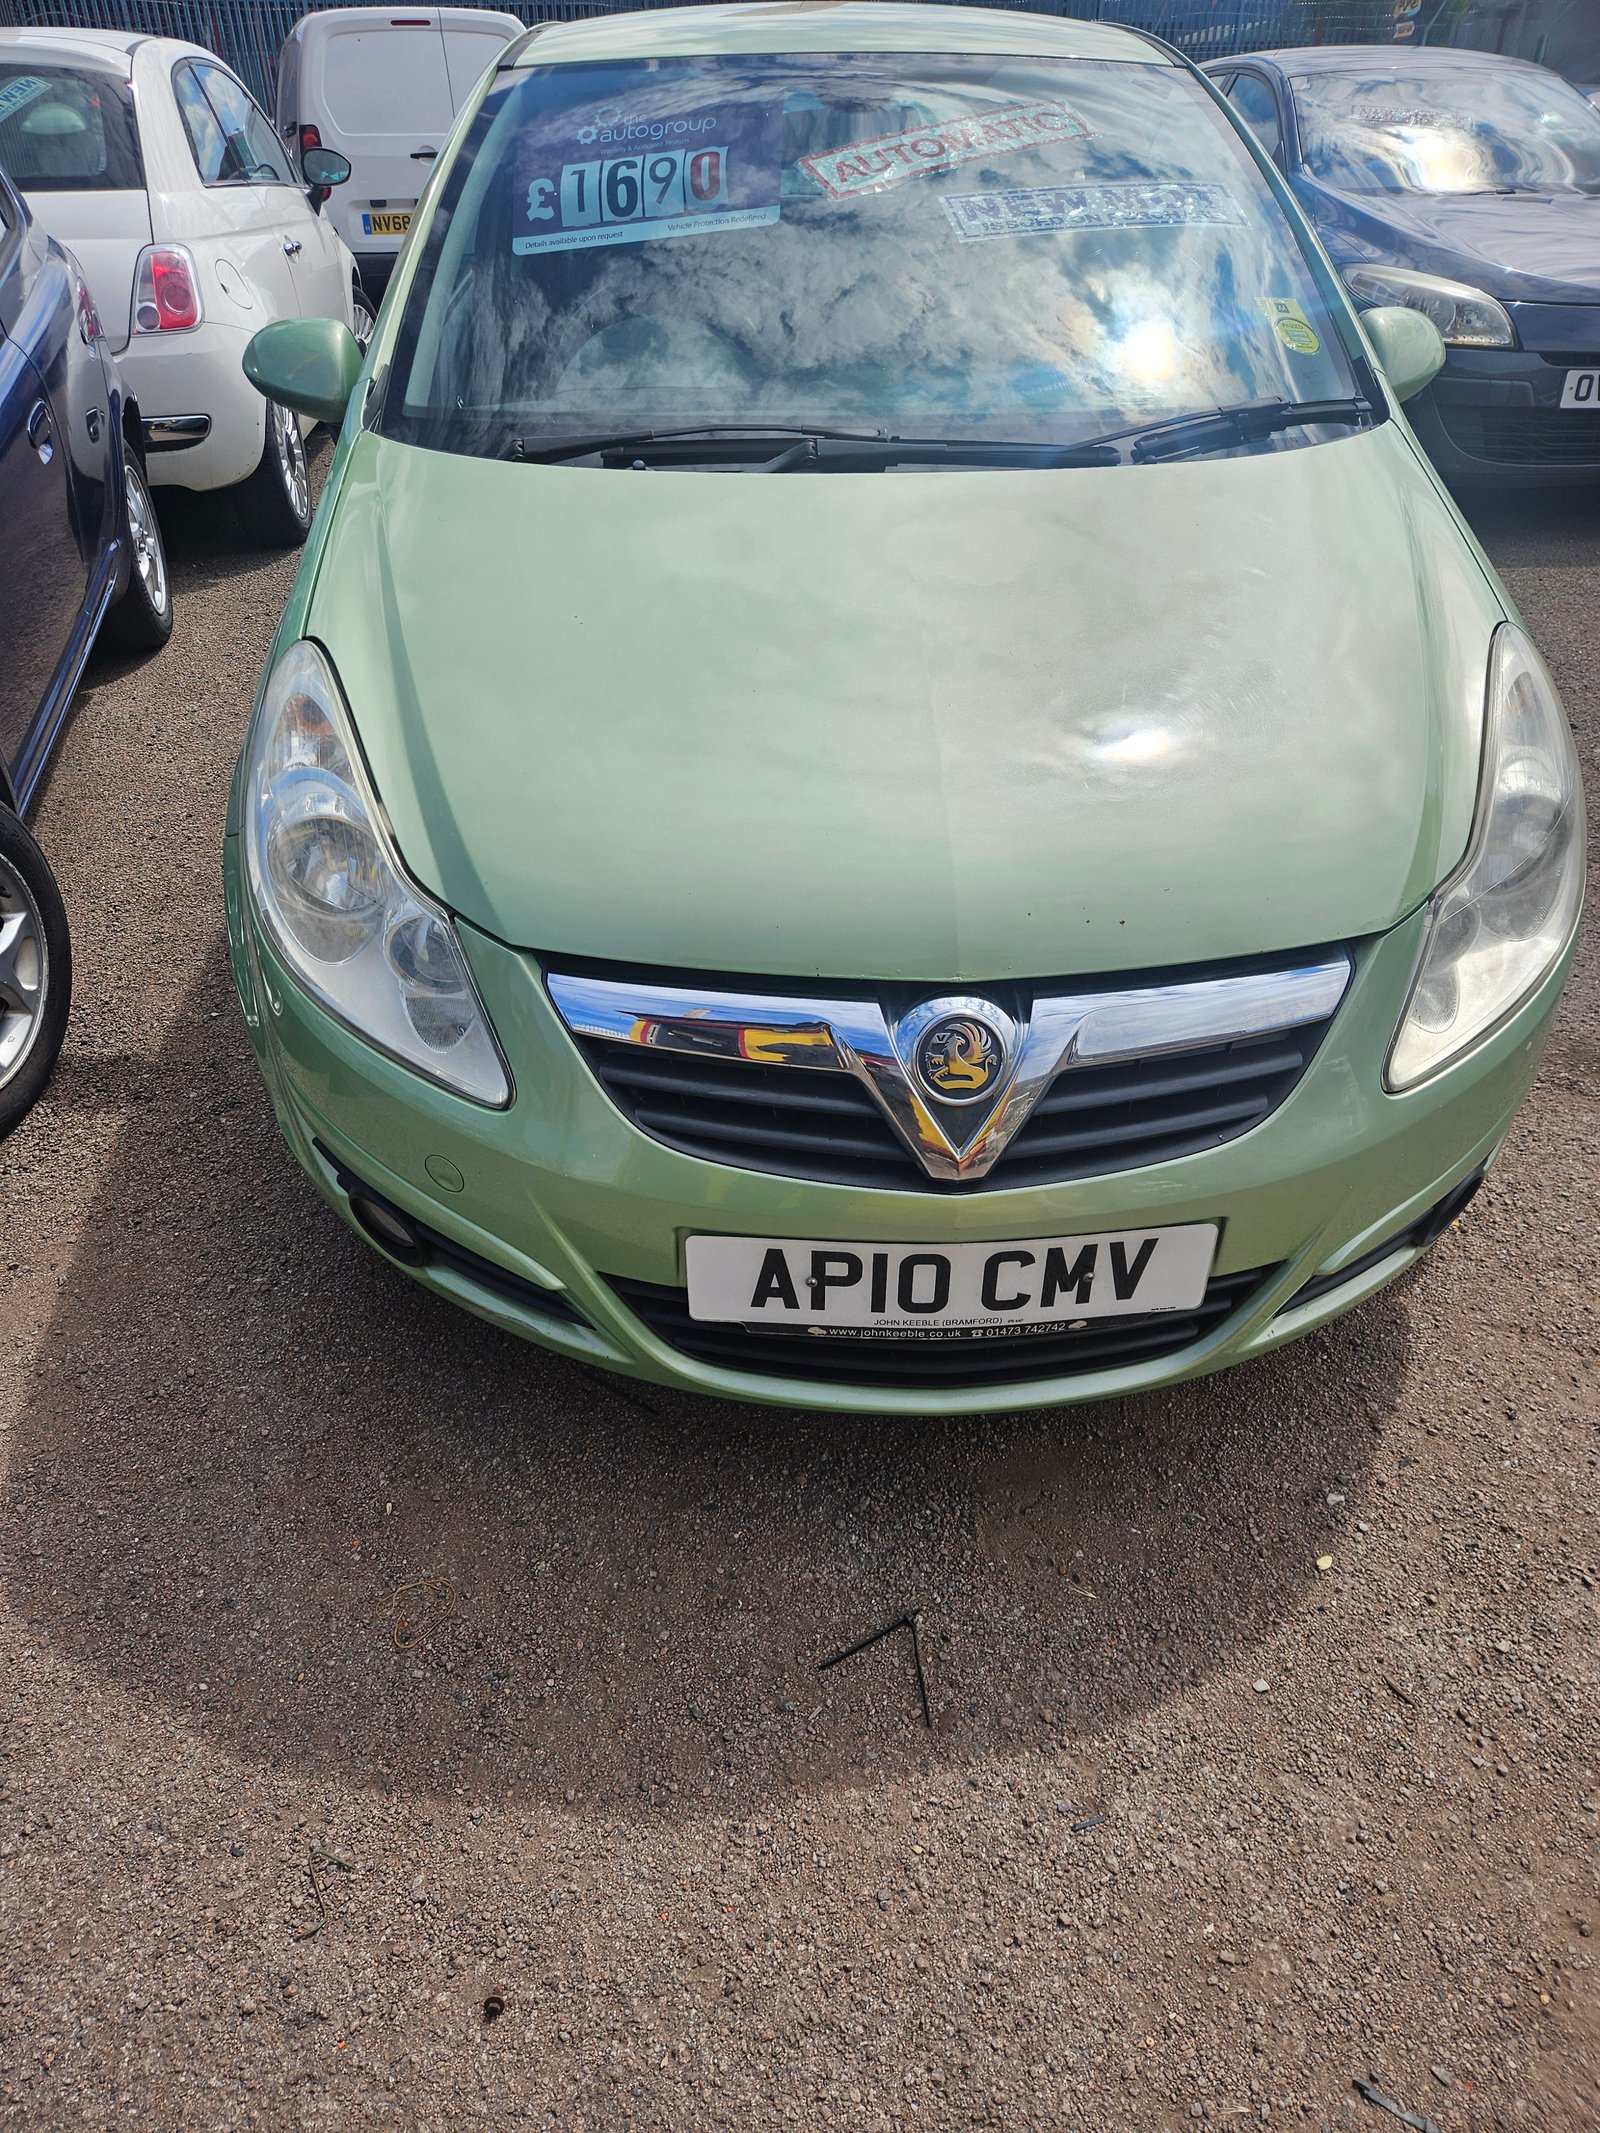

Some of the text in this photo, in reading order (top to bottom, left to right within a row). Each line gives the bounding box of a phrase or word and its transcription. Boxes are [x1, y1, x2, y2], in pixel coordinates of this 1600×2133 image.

[623, 114, 648, 125] the
[600, 117, 717, 143] autogroup
[834, 112, 1067, 184] AUTOMATIC
[958, 190, 1088, 222] NEW
[668, 212, 767, 231] Vehicle Protection Redefined
[525, 231, 623, 249] Details available upon request
[750, 1237, 1160, 1313] AP10 CMV
[829, 1322, 1066, 1338] www.johnkeeble.co.uk 01473 742742
[902, 1318, 940, 1327] KEEBLE
[942, 1317, 1003, 1327] (BRAMFORD)
